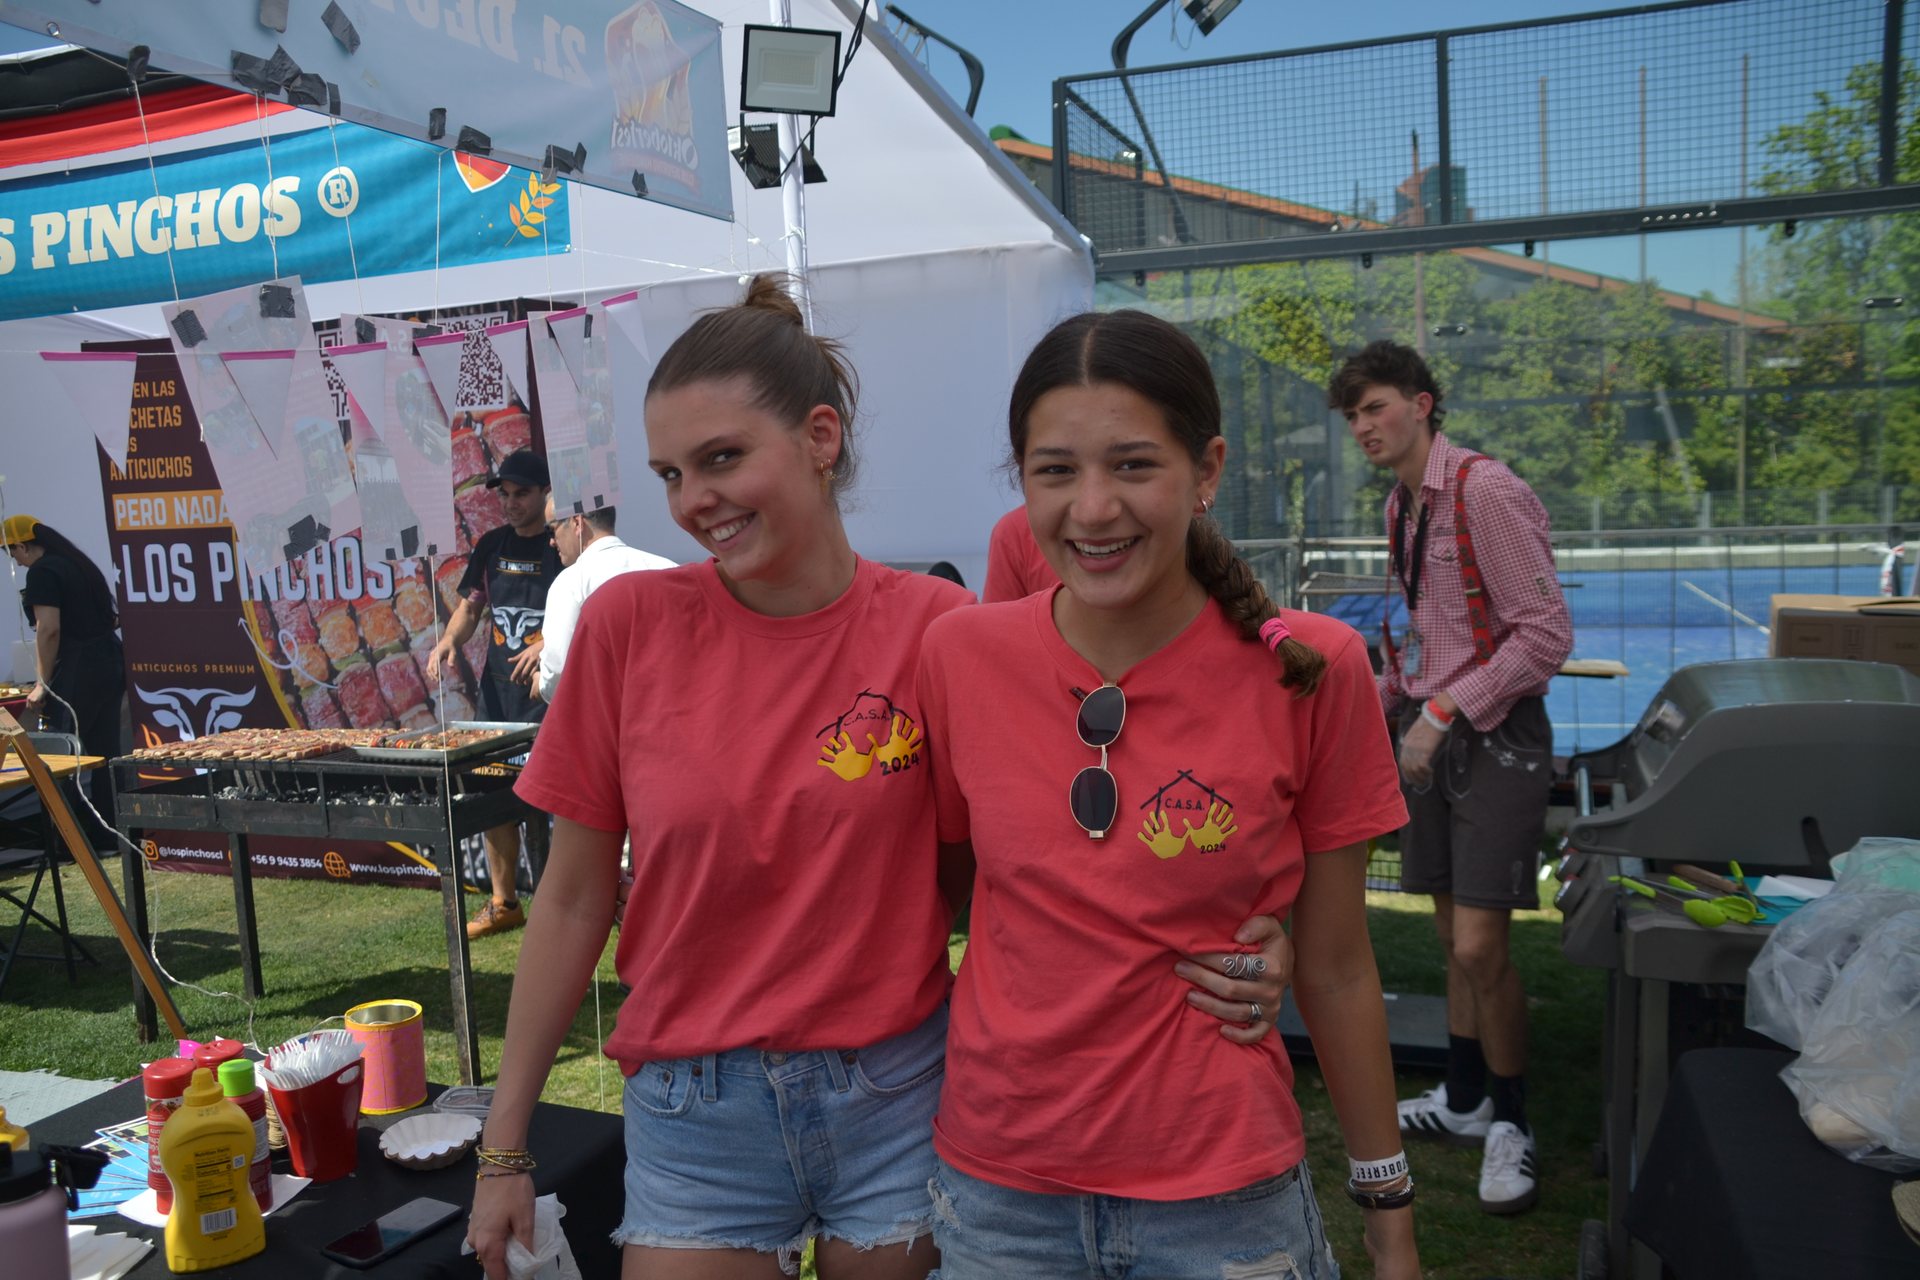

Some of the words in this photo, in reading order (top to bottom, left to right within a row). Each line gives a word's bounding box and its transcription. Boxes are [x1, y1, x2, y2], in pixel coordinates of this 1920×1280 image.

[31, 175, 302, 270] PINCHOS
[152, 380, 176, 397] LAS
[110, 455, 193, 481] ATICUCHOS
[115, 497, 167, 528] PERO
[173, 495, 232, 526] NADA
[122, 542, 197, 603] LOS
[132, 663, 198, 673] ANTICUCHOS
[204, 663, 255, 675] PREMIUM
[880, 752, 920, 777] 2024
[1165, 798, 1205, 811] C.A.S.A.
[158, 846, 224, 860] @lospinchoscl
[1200, 843, 1226, 855] 2024
[251, 854, 268, 865] +56
[269, 855, 276, 865] 9
[277, 856, 298, 867] 9435
[300, 858, 323, 868] 3854
